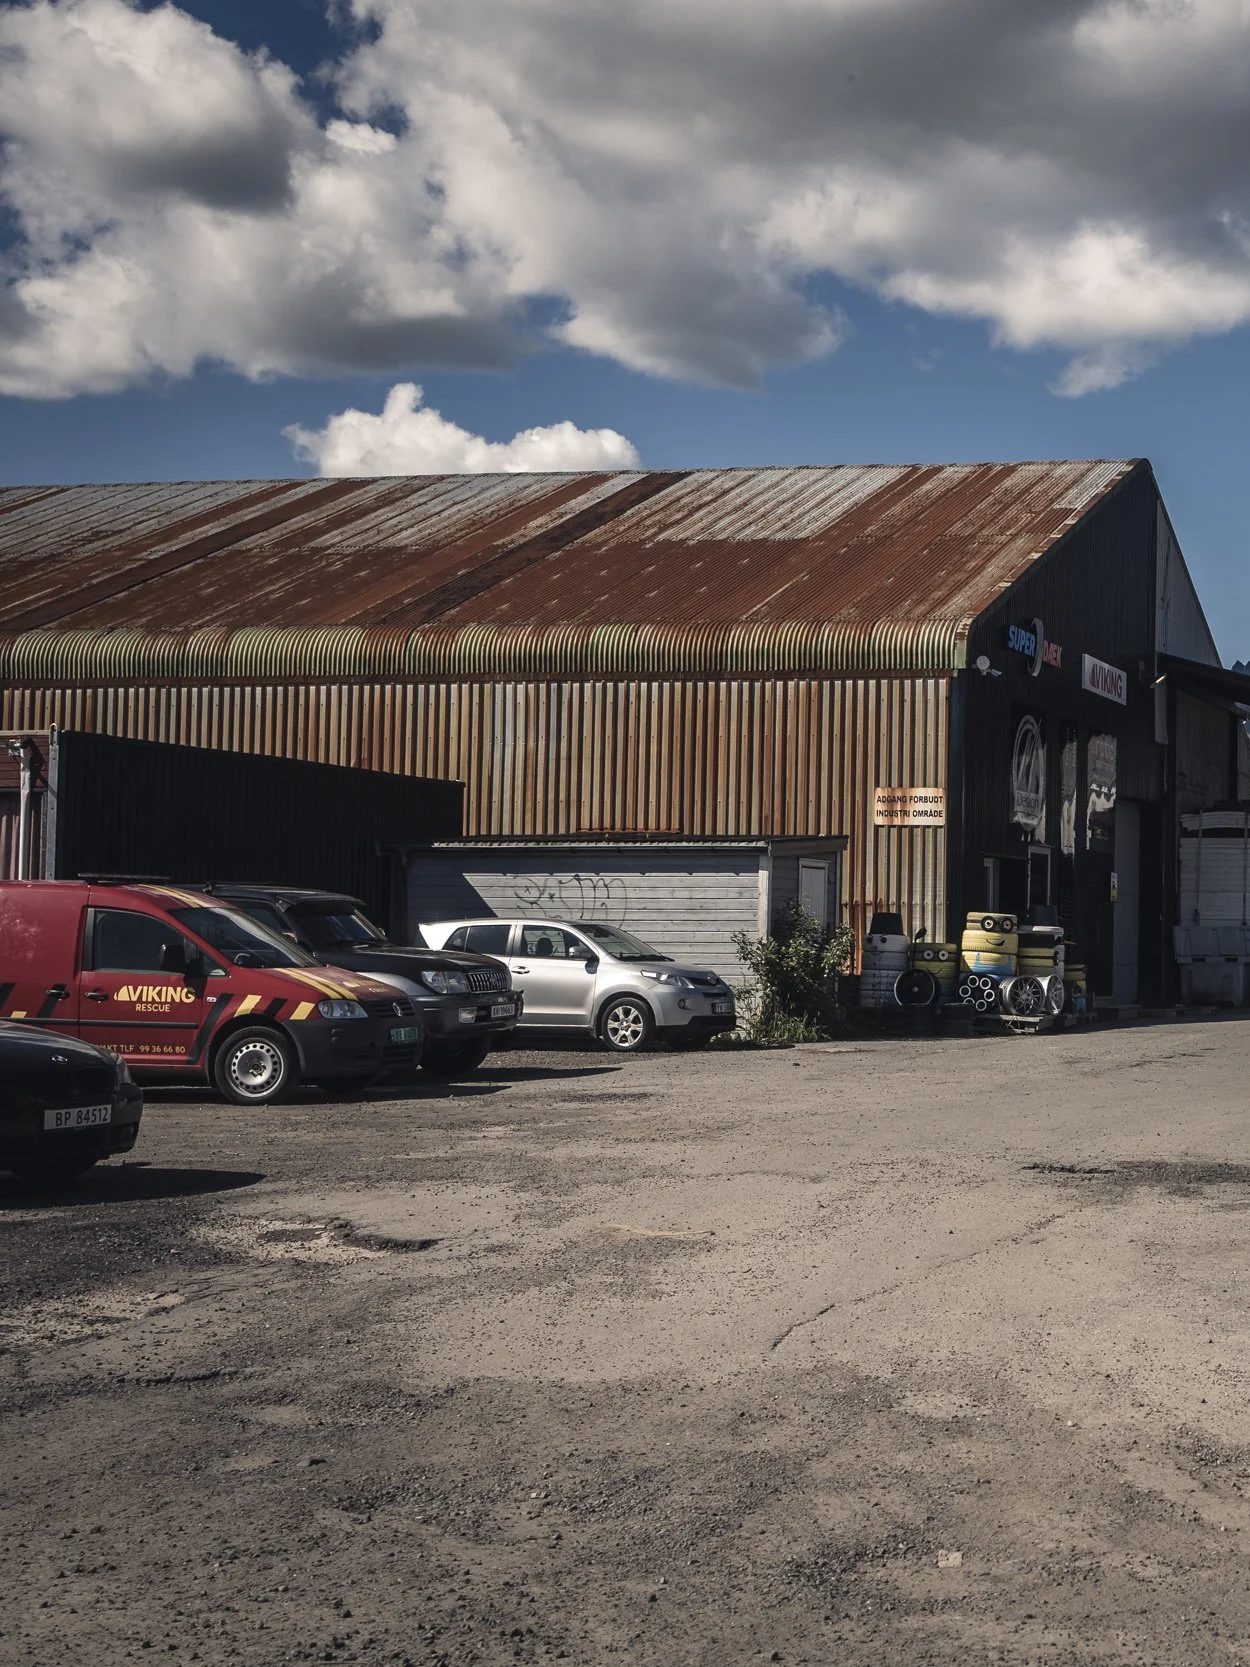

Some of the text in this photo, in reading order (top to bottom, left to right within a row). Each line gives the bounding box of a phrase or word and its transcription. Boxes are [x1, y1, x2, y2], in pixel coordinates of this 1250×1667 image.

[1008, 624, 1036, 657] SUPER
[1094, 665, 1122, 698] VIKING
[877, 795, 943, 804] ADGANG FORBUDT
[1017, 792, 1039, 813] Design
[876, 808, 943, 817] INDUSTRI OMRÅDE
[128, 985, 196, 1003] VIKING
[135, 1003, 171, 1012] RESCUE
[120, 1045, 135, 1053] TLF
[139, 1045, 150, 1053] 99
[152, 1045, 161, 1053] 36
[175, 1046, 186, 1054] 80
[55, 1107, 108, 1127] BP 84512
